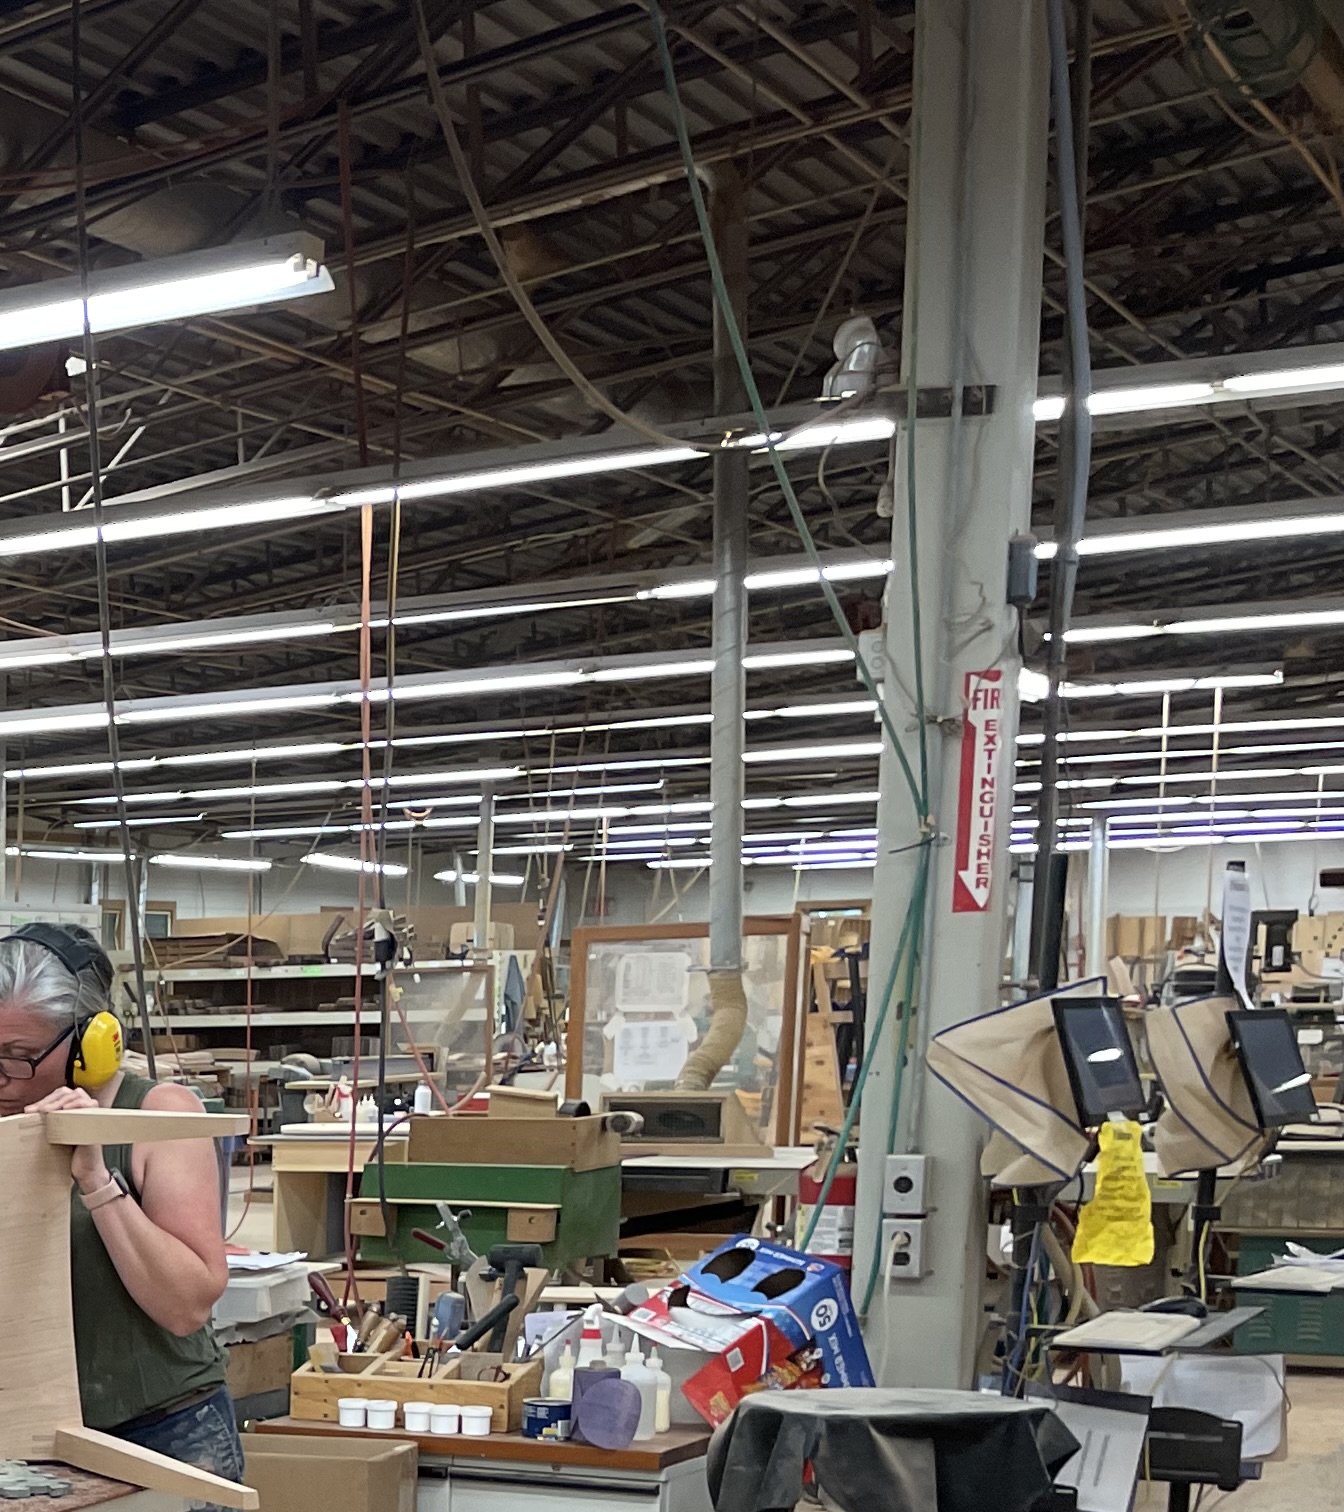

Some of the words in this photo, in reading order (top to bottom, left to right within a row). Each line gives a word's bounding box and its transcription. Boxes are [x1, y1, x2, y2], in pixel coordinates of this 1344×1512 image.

[972, 688, 1000, 710] FIR
[975, 719, 997, 889] EXTINGUISHER
[815, 1304, 831, 1328] 50
